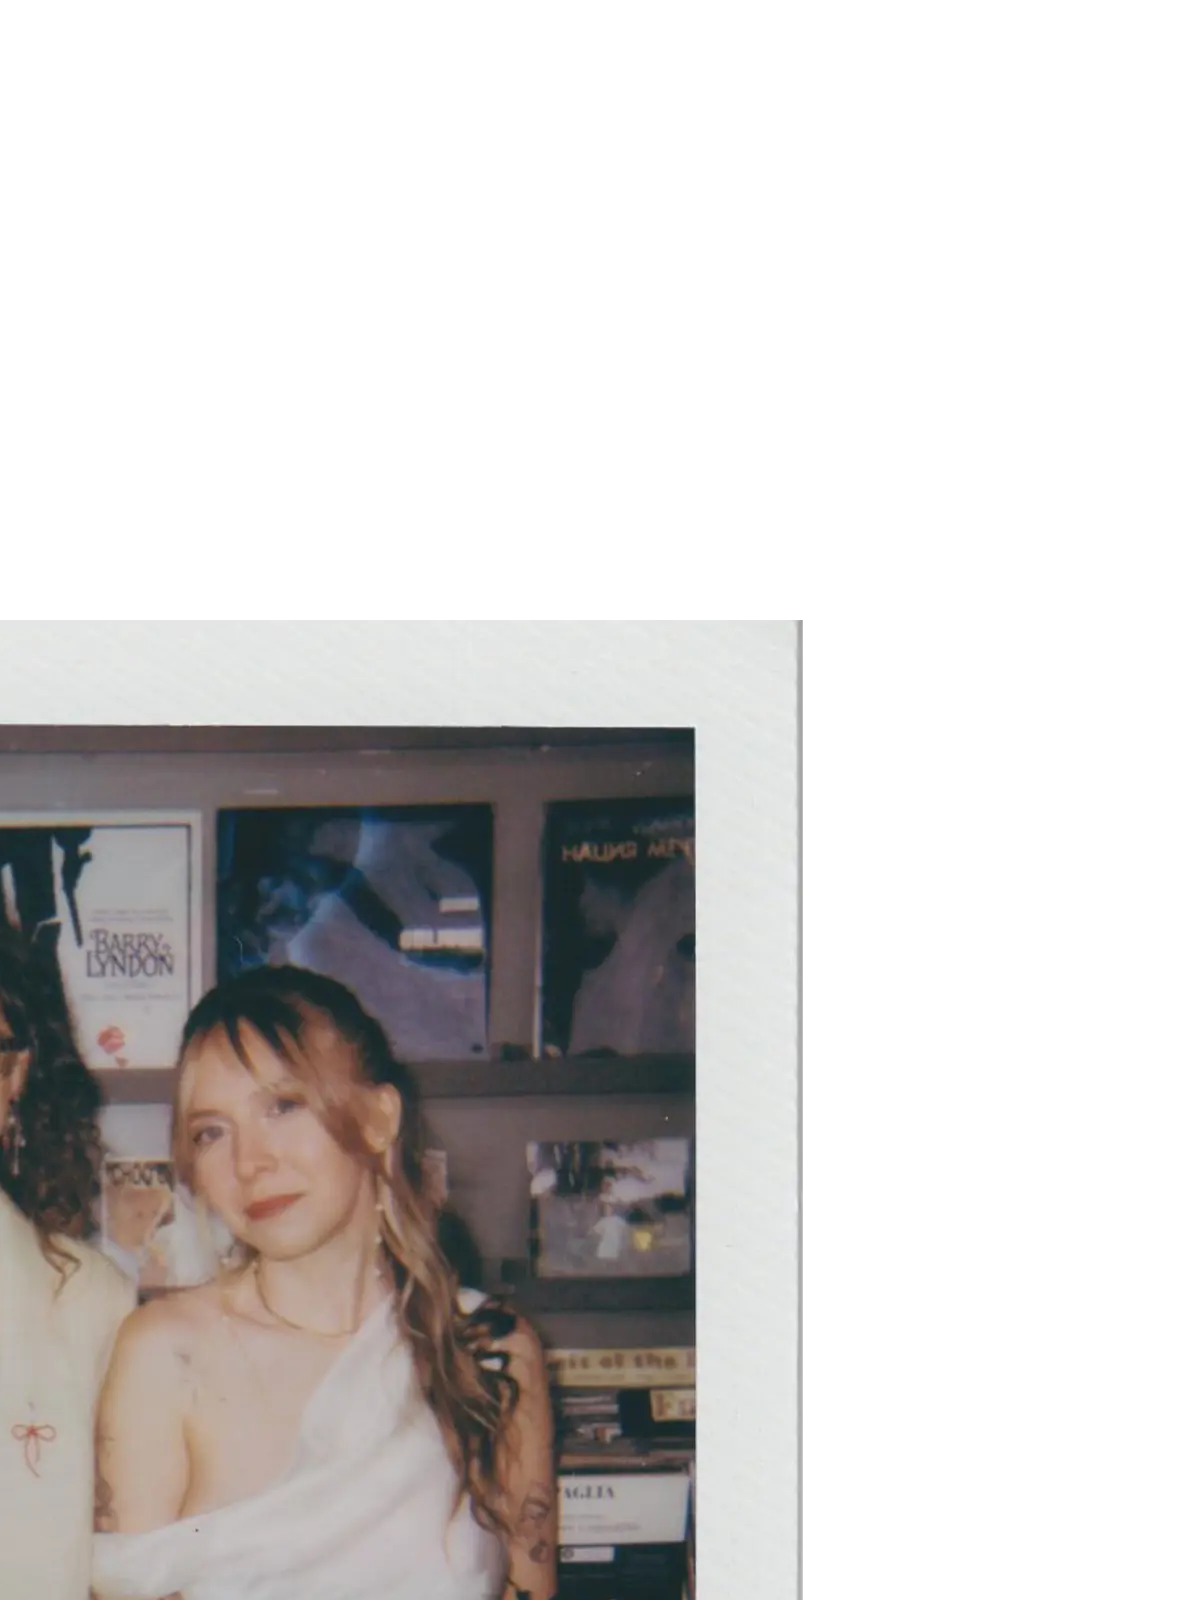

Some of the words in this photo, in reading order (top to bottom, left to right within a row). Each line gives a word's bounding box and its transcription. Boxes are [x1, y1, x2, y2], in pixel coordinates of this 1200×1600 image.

[89, 928, 165, 954] BARRY
[86, 948, 175, 978] LYNDON
[557, 1484, 616, 1500] AGLIA
